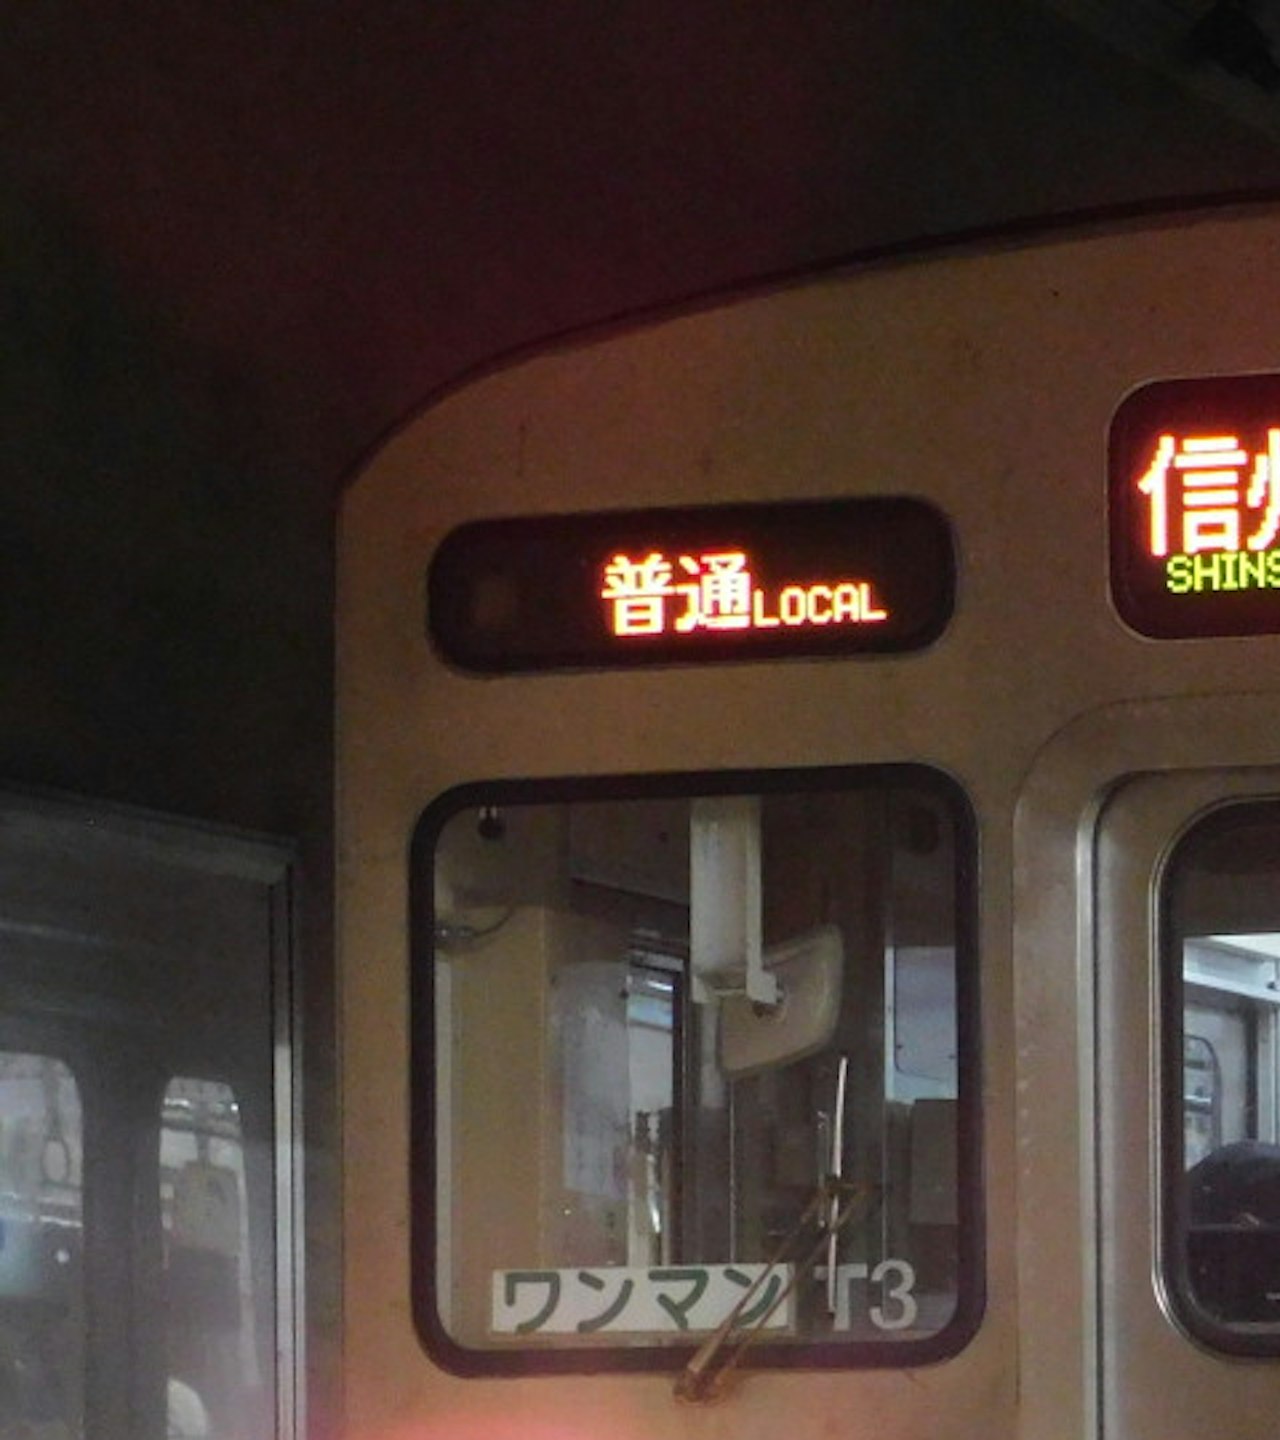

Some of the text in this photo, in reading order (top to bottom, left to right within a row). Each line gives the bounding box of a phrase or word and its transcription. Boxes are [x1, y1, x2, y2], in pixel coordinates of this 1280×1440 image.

[601, 553, 750, 636] 普通
[753, 583, 887, 628] LOCAL
[505, 1267, 782, 1333] ワンマン
[814, 1259, 917, 1332] T3
